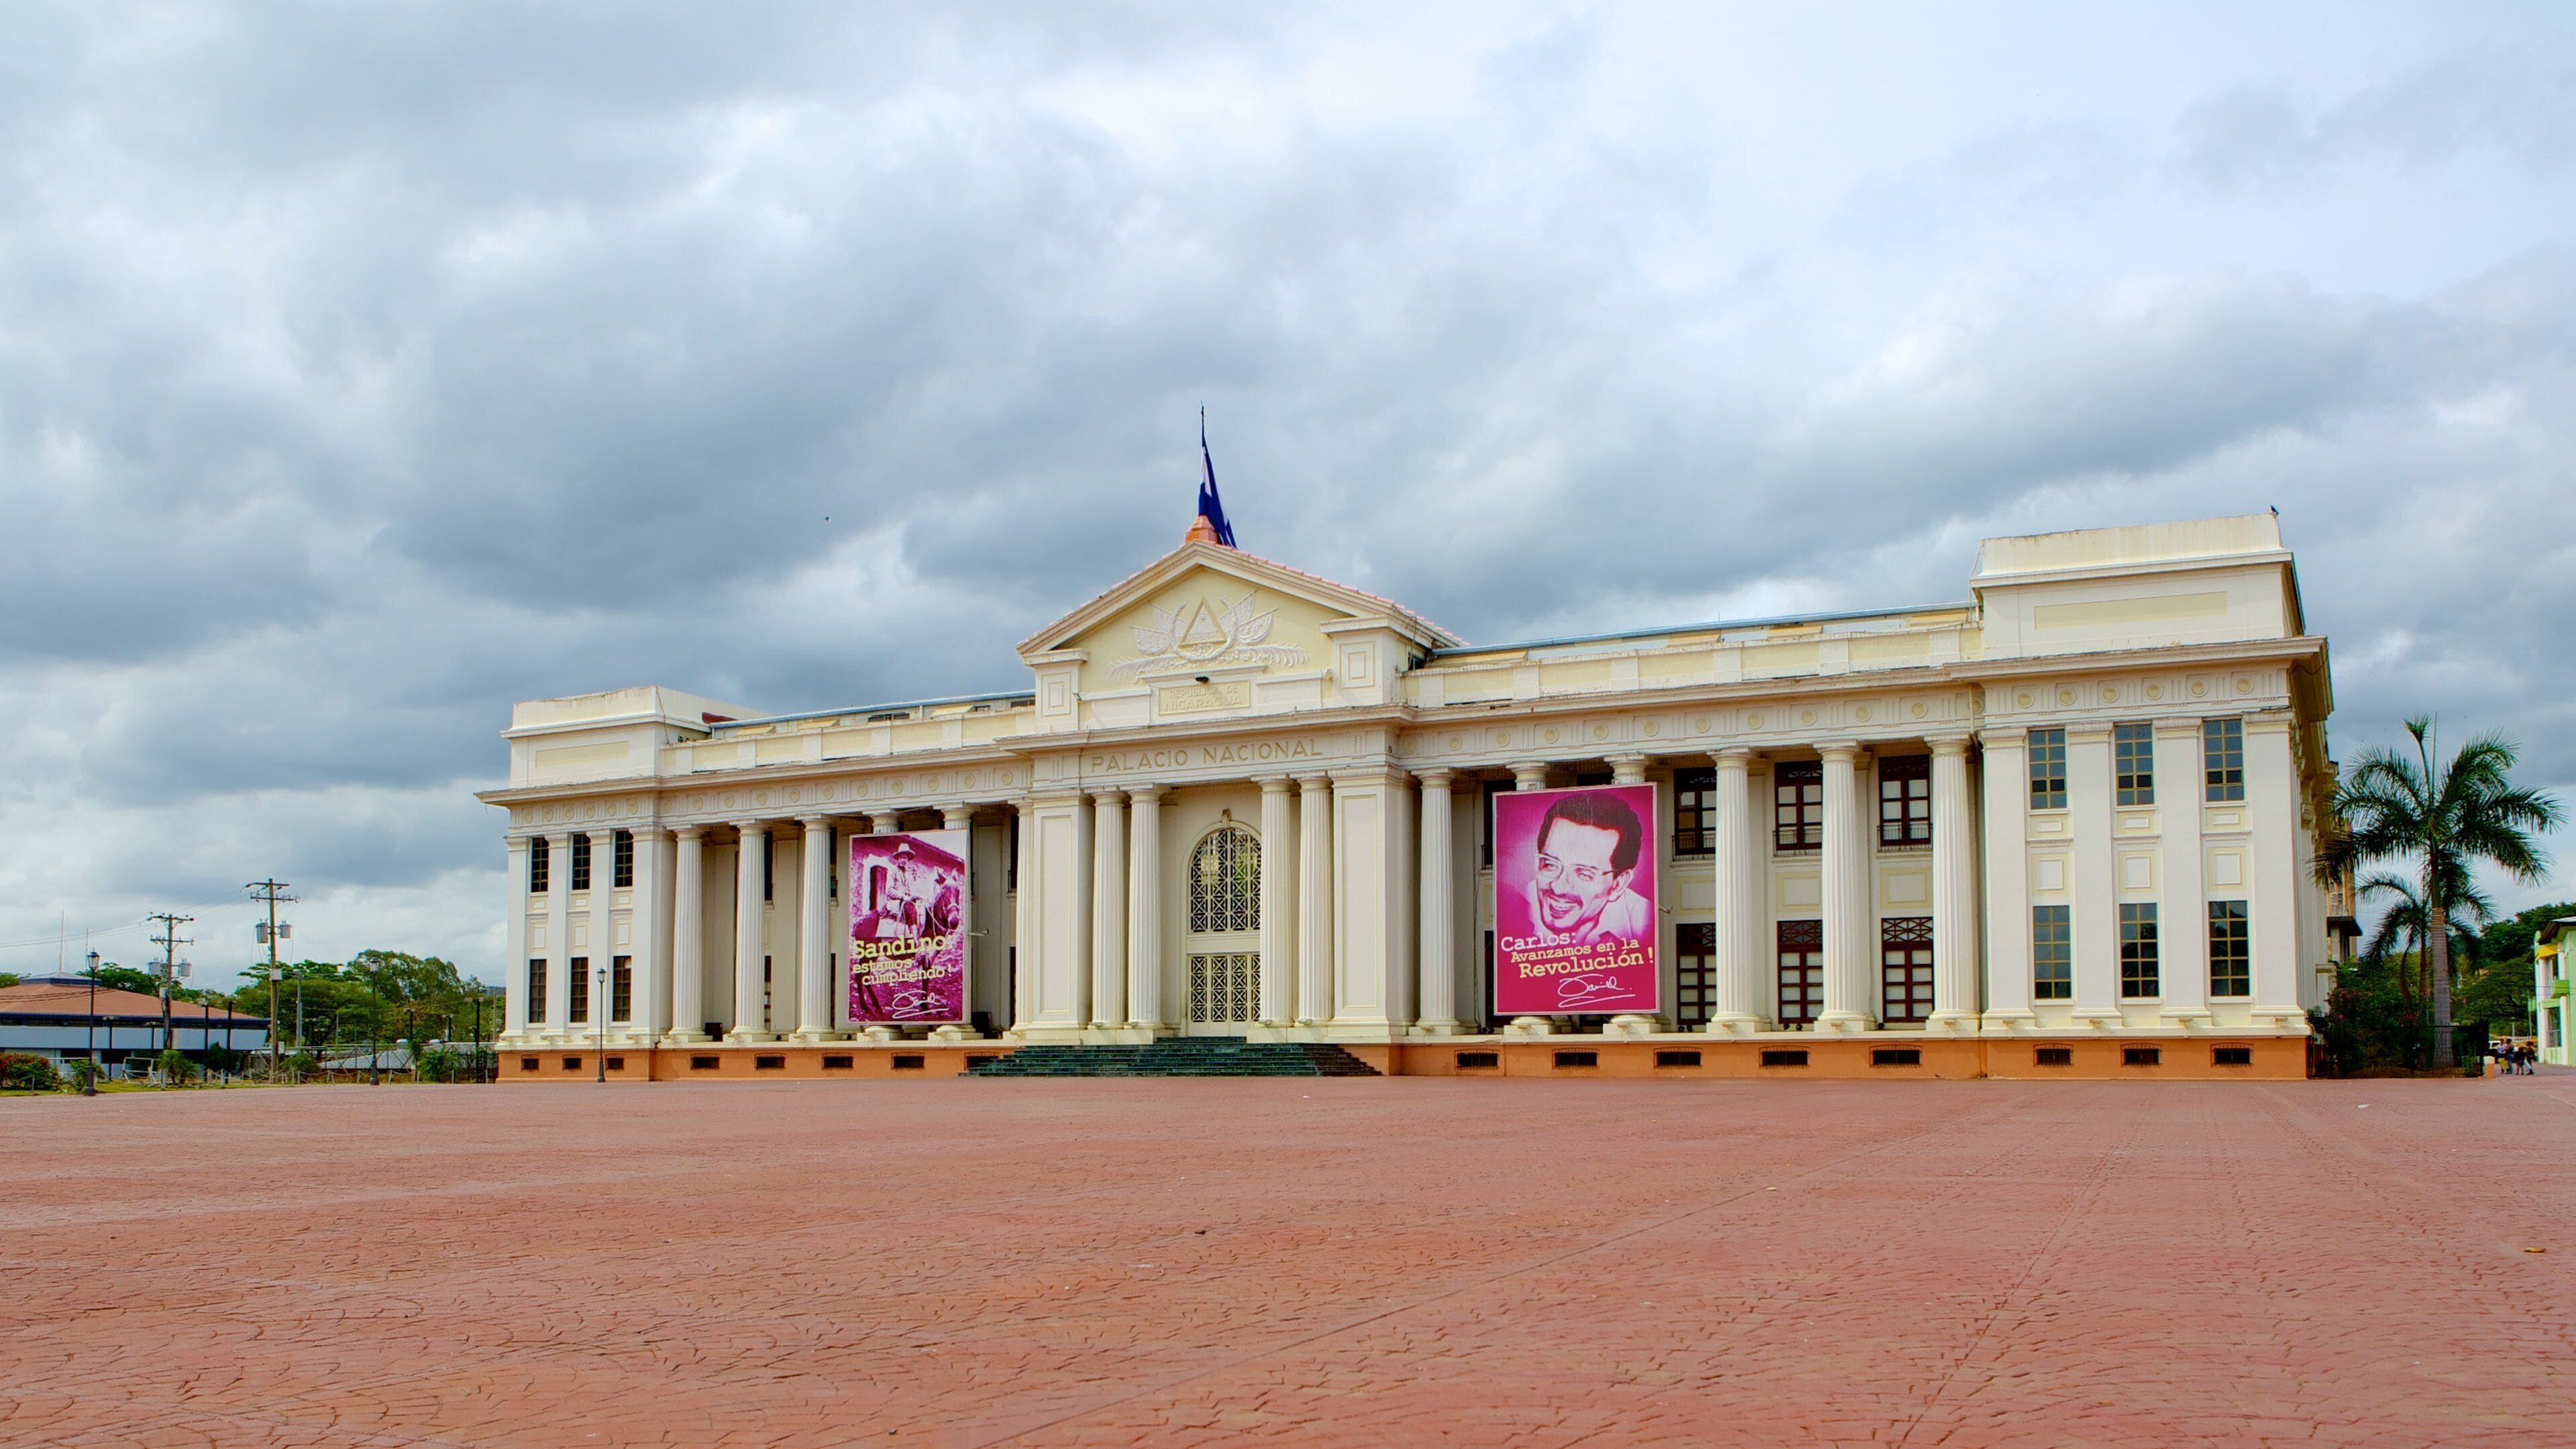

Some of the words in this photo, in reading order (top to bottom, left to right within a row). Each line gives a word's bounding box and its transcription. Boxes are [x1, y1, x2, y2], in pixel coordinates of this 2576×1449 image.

[1227, 684, 1239, 694] DE
[1165, 695, 1243, 711] NICARAGUA
[1091, 749, 1189, 772] PALACIO
[1203, 739, 1324, 764] NACIONAL
[1500, 931, 1576, 952] Carlos:
[1511, 944, 1592, 963] Avanzamos
[1597, 942, 1616, 953] en
[1621, 937, 1640, 950] la
[853, 958, 912, 973] estamos
